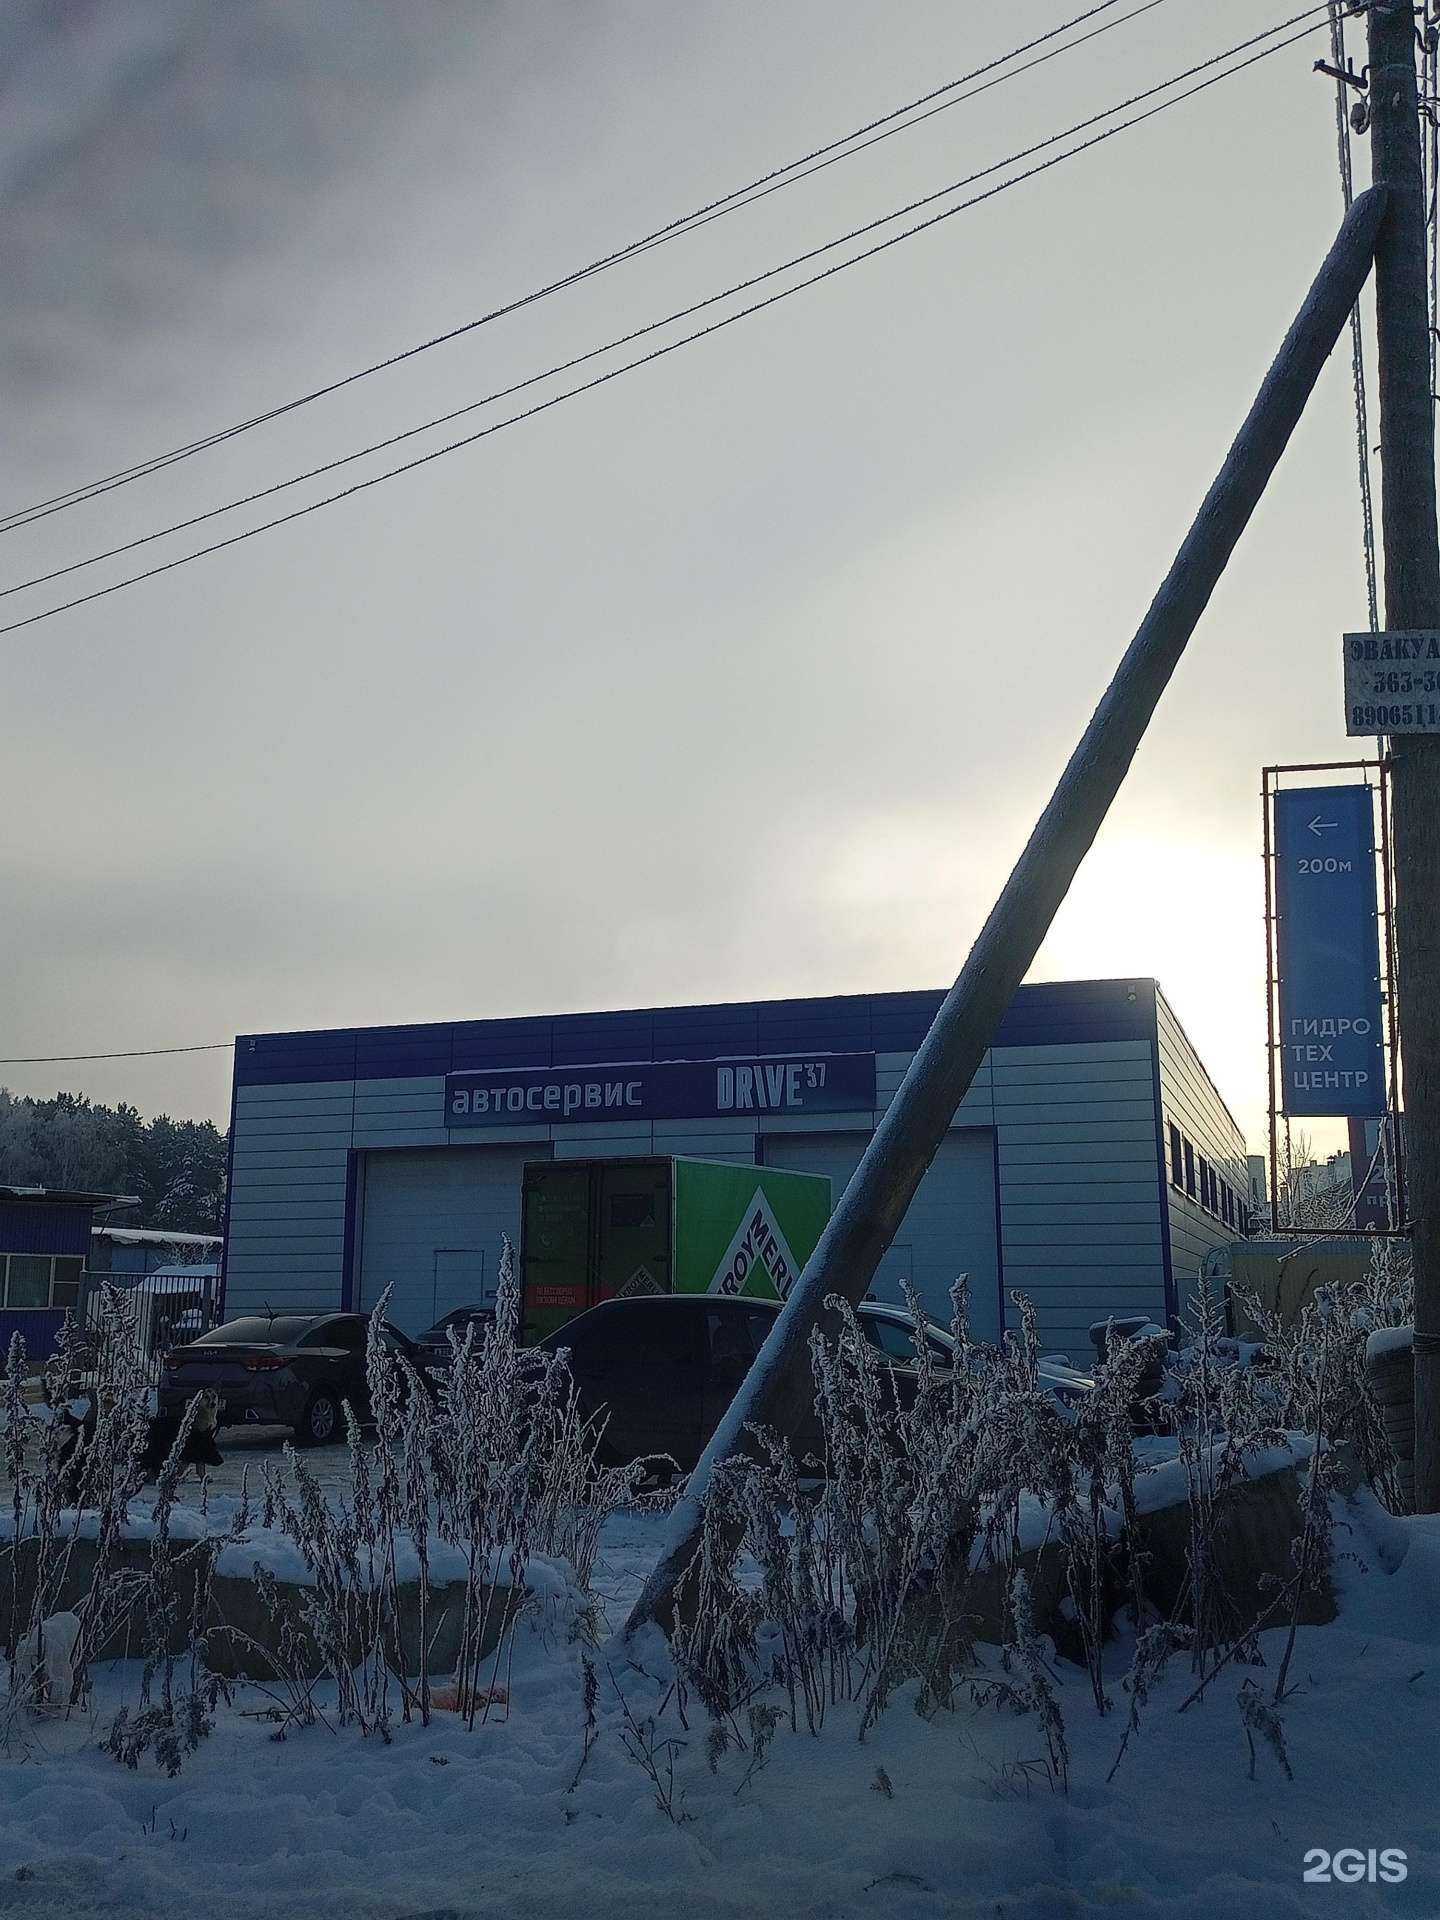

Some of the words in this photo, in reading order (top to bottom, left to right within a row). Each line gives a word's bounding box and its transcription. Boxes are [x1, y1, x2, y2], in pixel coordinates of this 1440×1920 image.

[1352, 704, 1440, 726] 8906511
[1291, 1018, 1371, 1037] ГИДРО
[1291, 1045, 1334, 1062] ТЕХ
[1293, 1071, 1369, 1090] ЦЕНТР
[452, 1081, 642, 1116] автосервис
[717, 1228, 754, 1296] ROY
